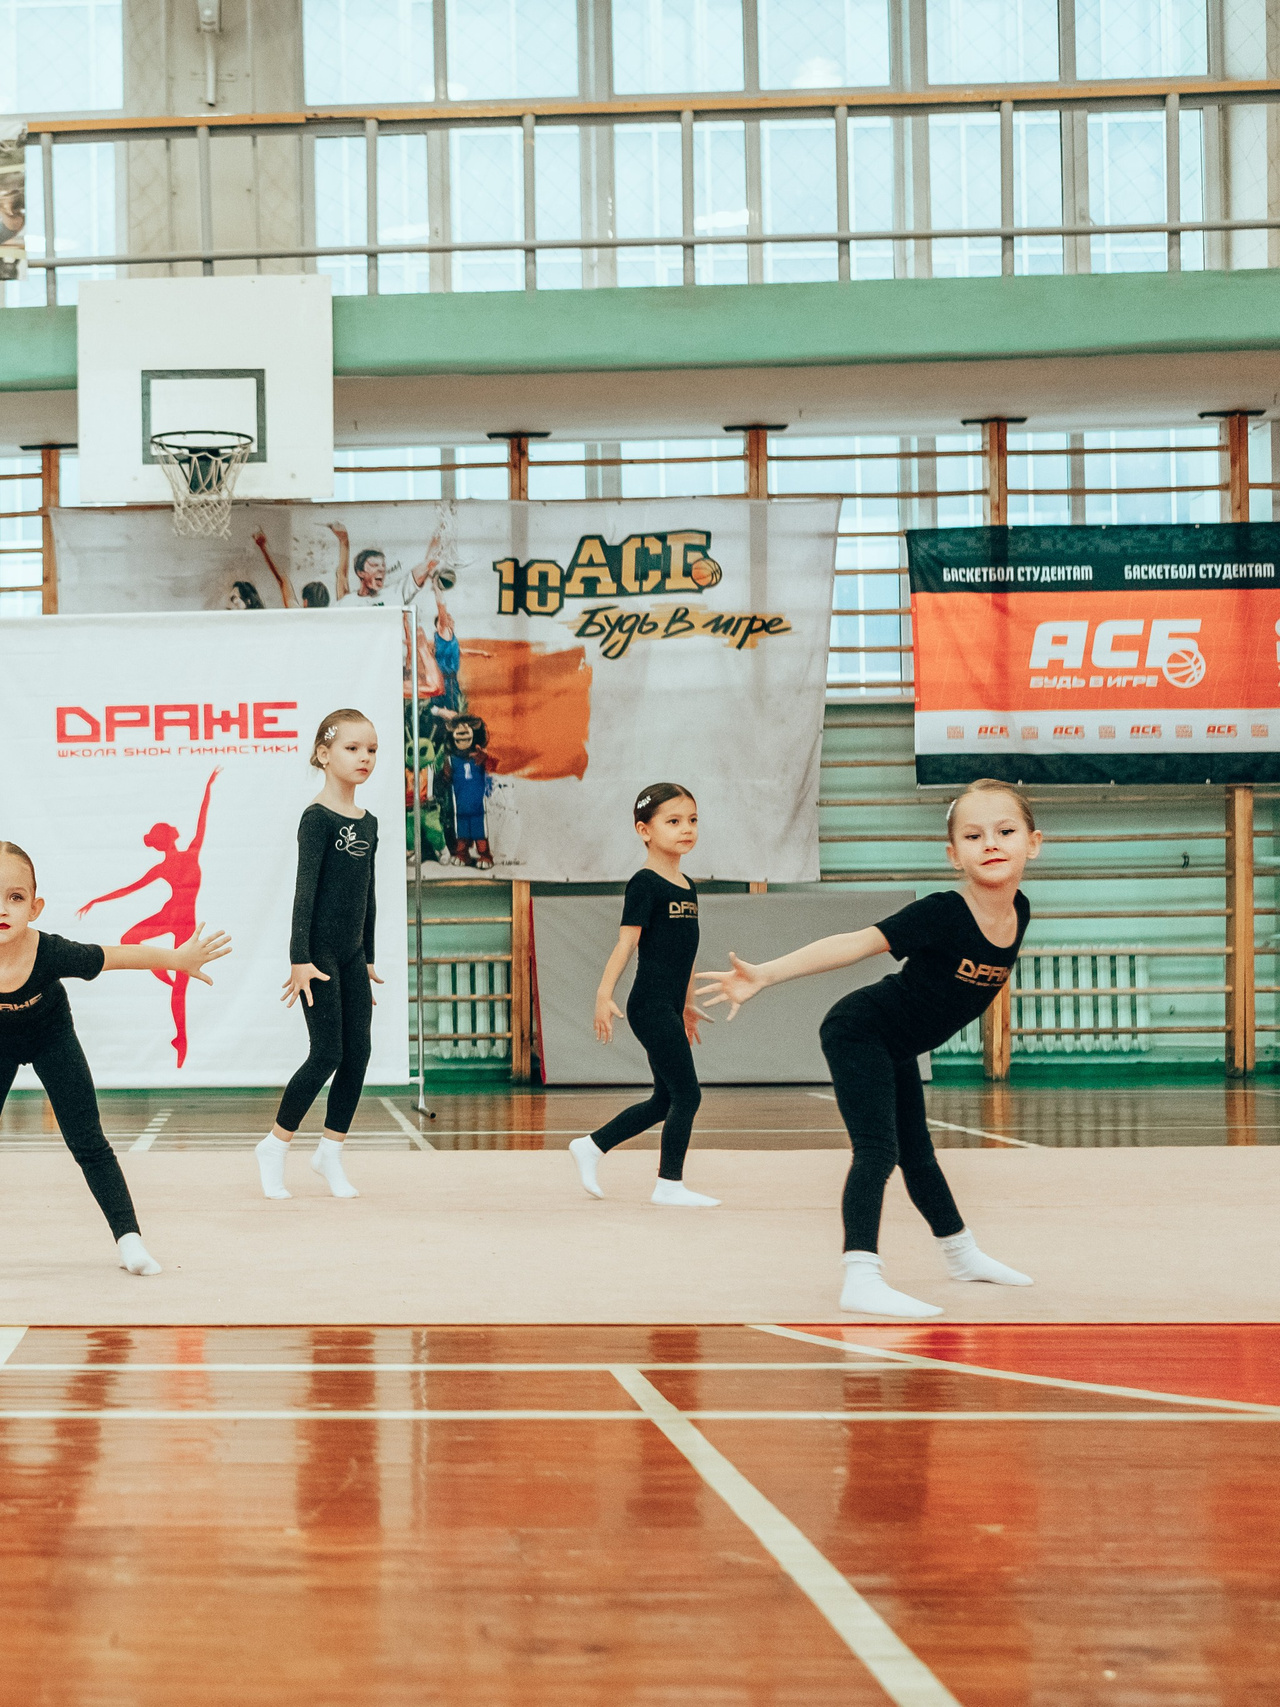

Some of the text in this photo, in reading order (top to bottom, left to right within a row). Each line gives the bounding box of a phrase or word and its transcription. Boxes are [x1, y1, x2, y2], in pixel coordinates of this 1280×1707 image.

[942, 565, 1093, 583] БАСКЕТБОЛ СТУДЕНТАМ
[1124, 563, 1275, 580] БАСКЕТБОЛ СТУДЕНТАМ
[1029, 618, 1205, 672] АСБ
[1107, 675, 1159, 688] ИГРЕ
[56, 701, 299, 743] ДРАЖЕ
[58, 748, 117, 758] ШКОЛА
[178, 744, 299, 756] ГИМНАСТИКИ
